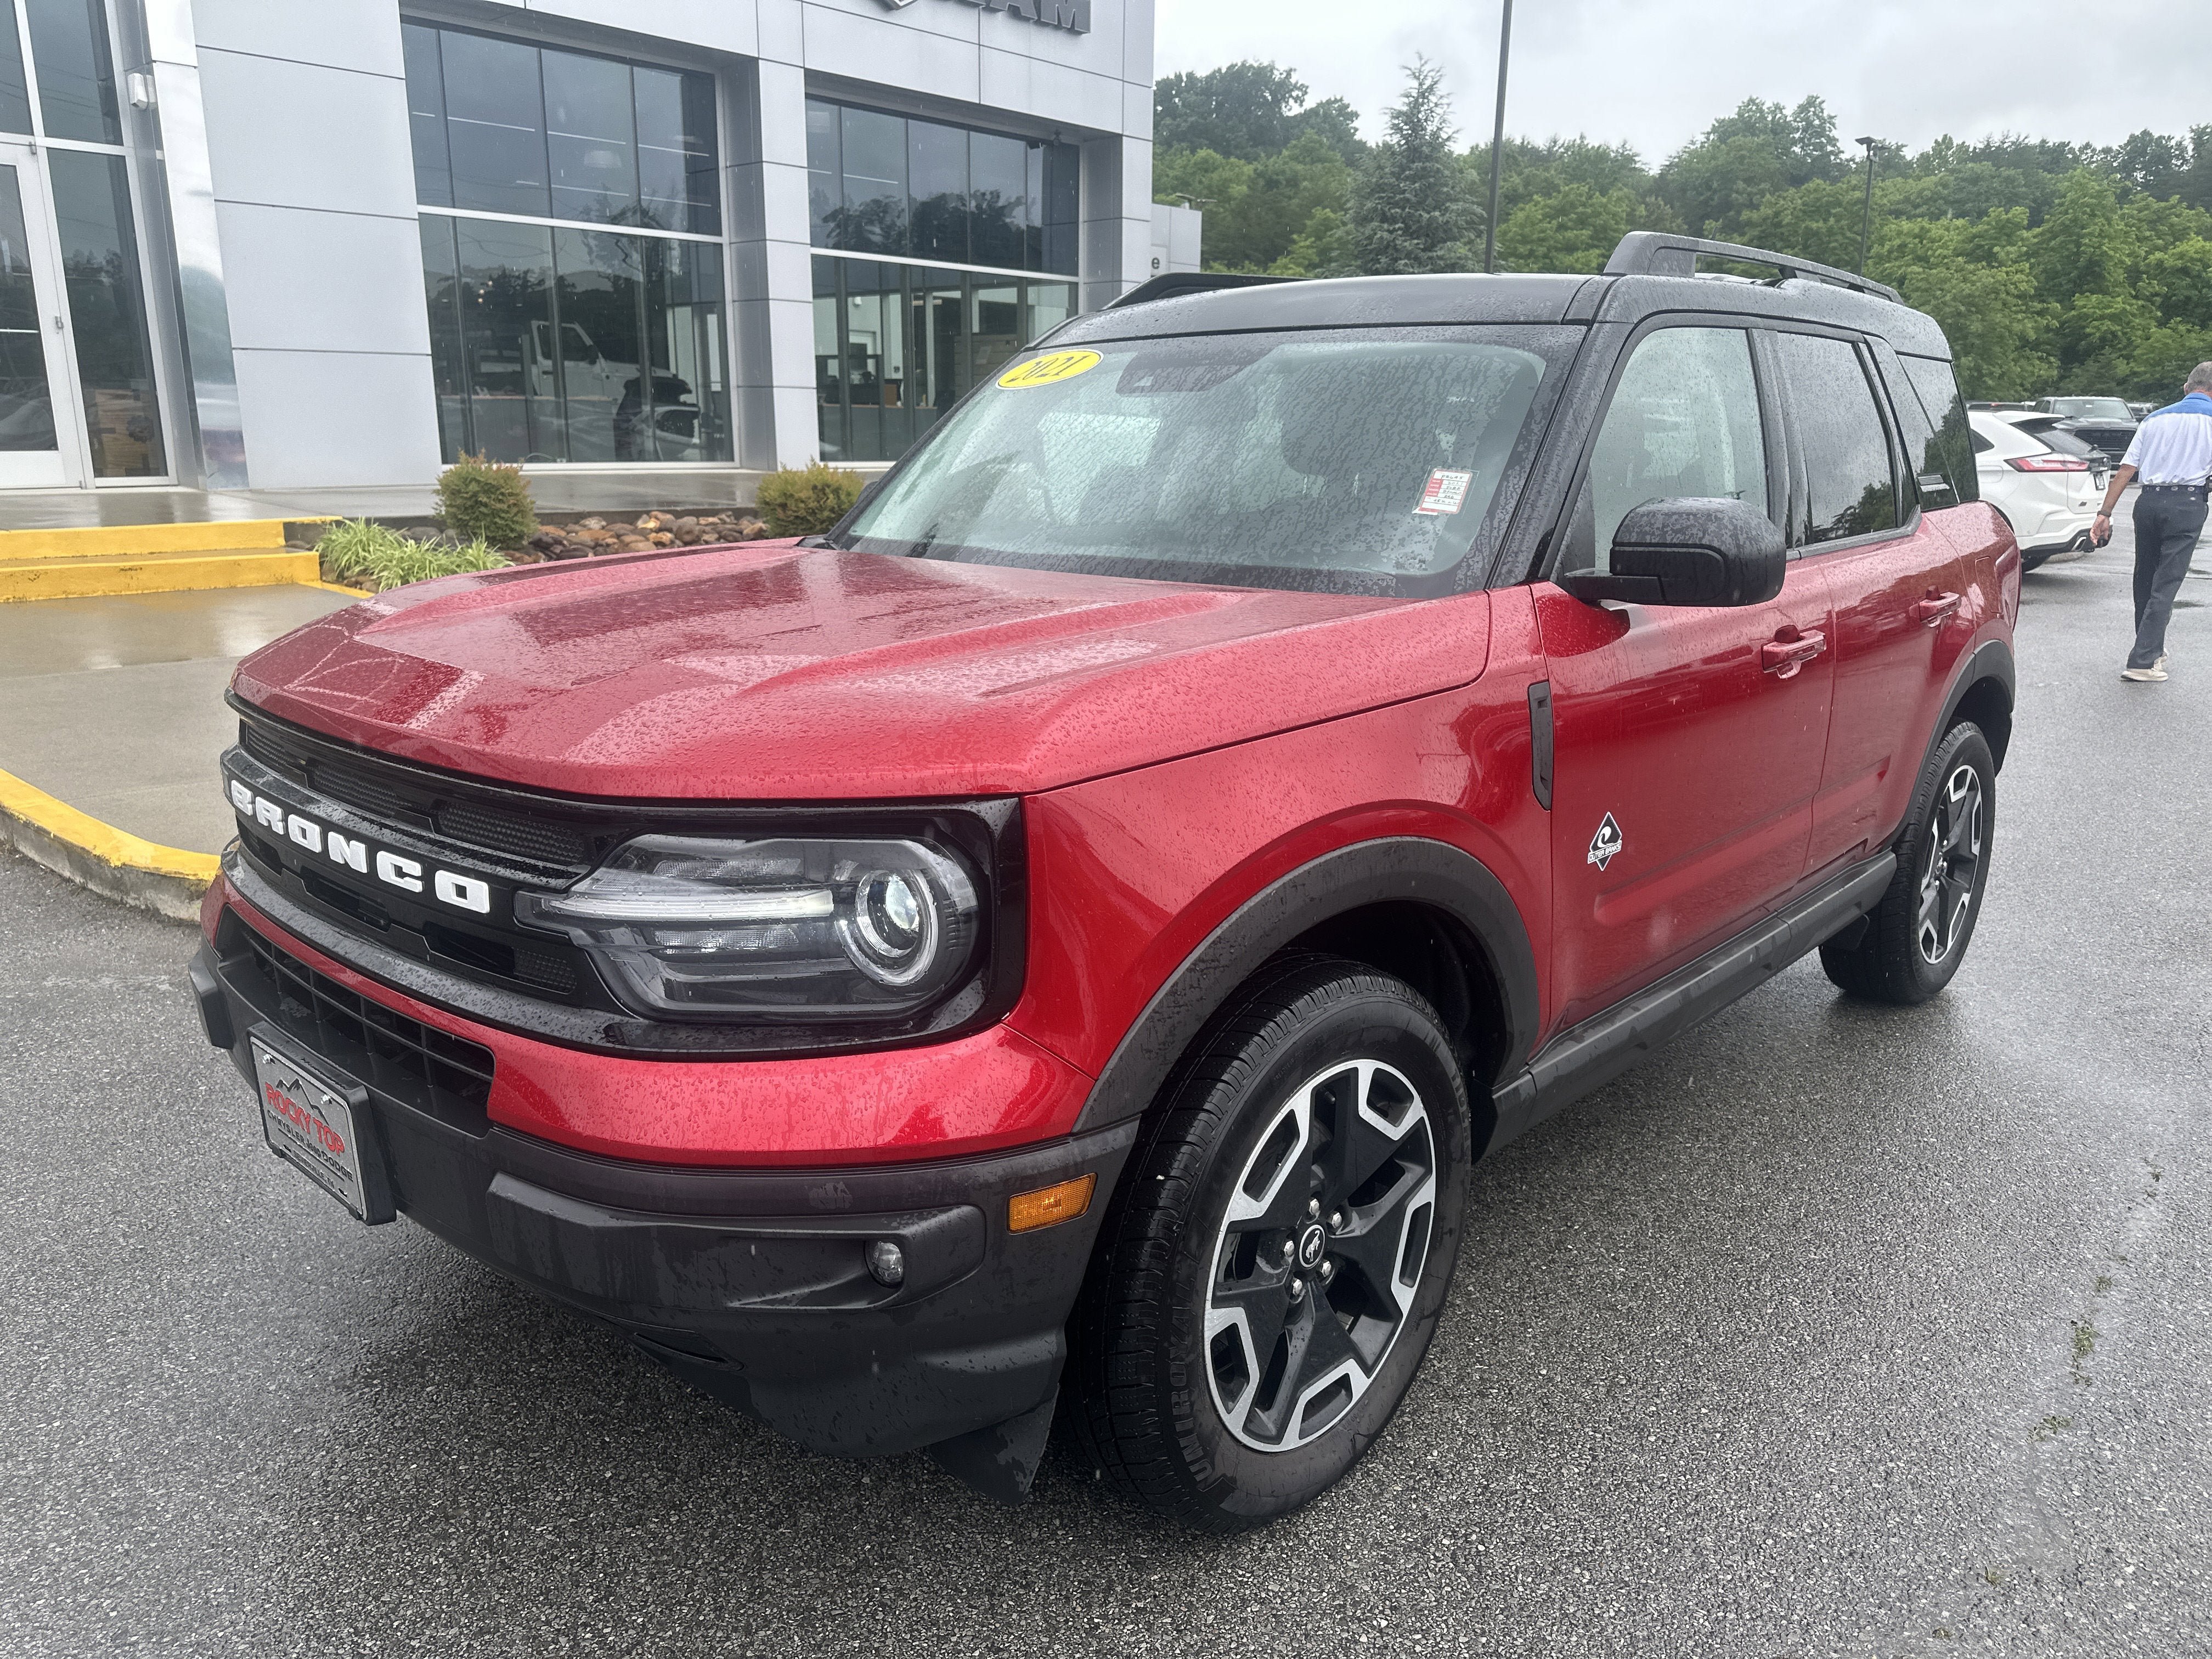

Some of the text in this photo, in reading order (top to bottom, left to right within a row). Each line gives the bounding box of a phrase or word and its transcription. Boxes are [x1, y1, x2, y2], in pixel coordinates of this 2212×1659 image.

[1005, 355, 1091, 383] 2021
[230, 779, 490, 914] BRONCO
[1589, 843, 1621, 861] OUTER BANKS
[264, 1081, 345, 1157] ROCKY TOP
[267, 1109, 306, 1144] CHRYSLER
[321, 1150, 354, 1183] DODGE
[1169, 1277, 1214, 1482] UNIROYAL
